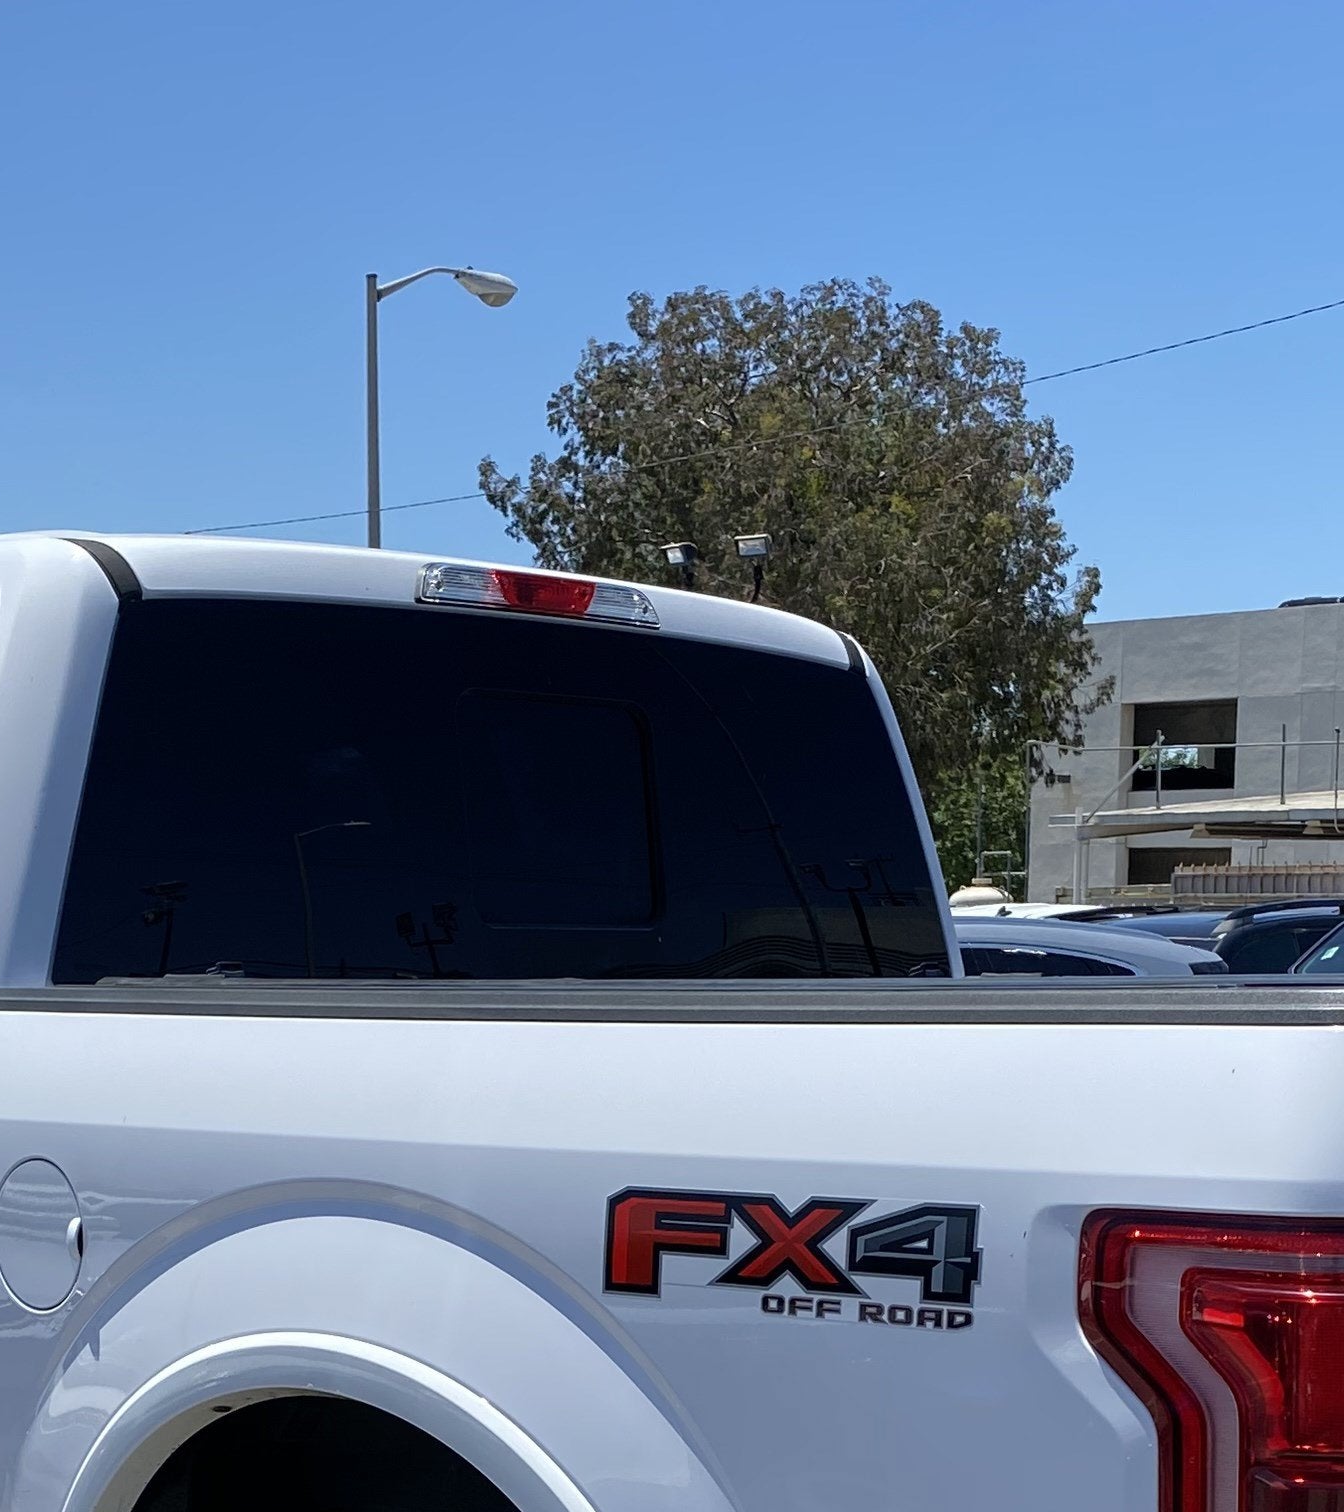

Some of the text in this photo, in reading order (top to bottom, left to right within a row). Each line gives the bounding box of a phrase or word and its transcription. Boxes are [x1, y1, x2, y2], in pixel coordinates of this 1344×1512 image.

[603, 1186, 984, 1308] FX4
[760, 1292, 975, 1331] OFF ROAD
